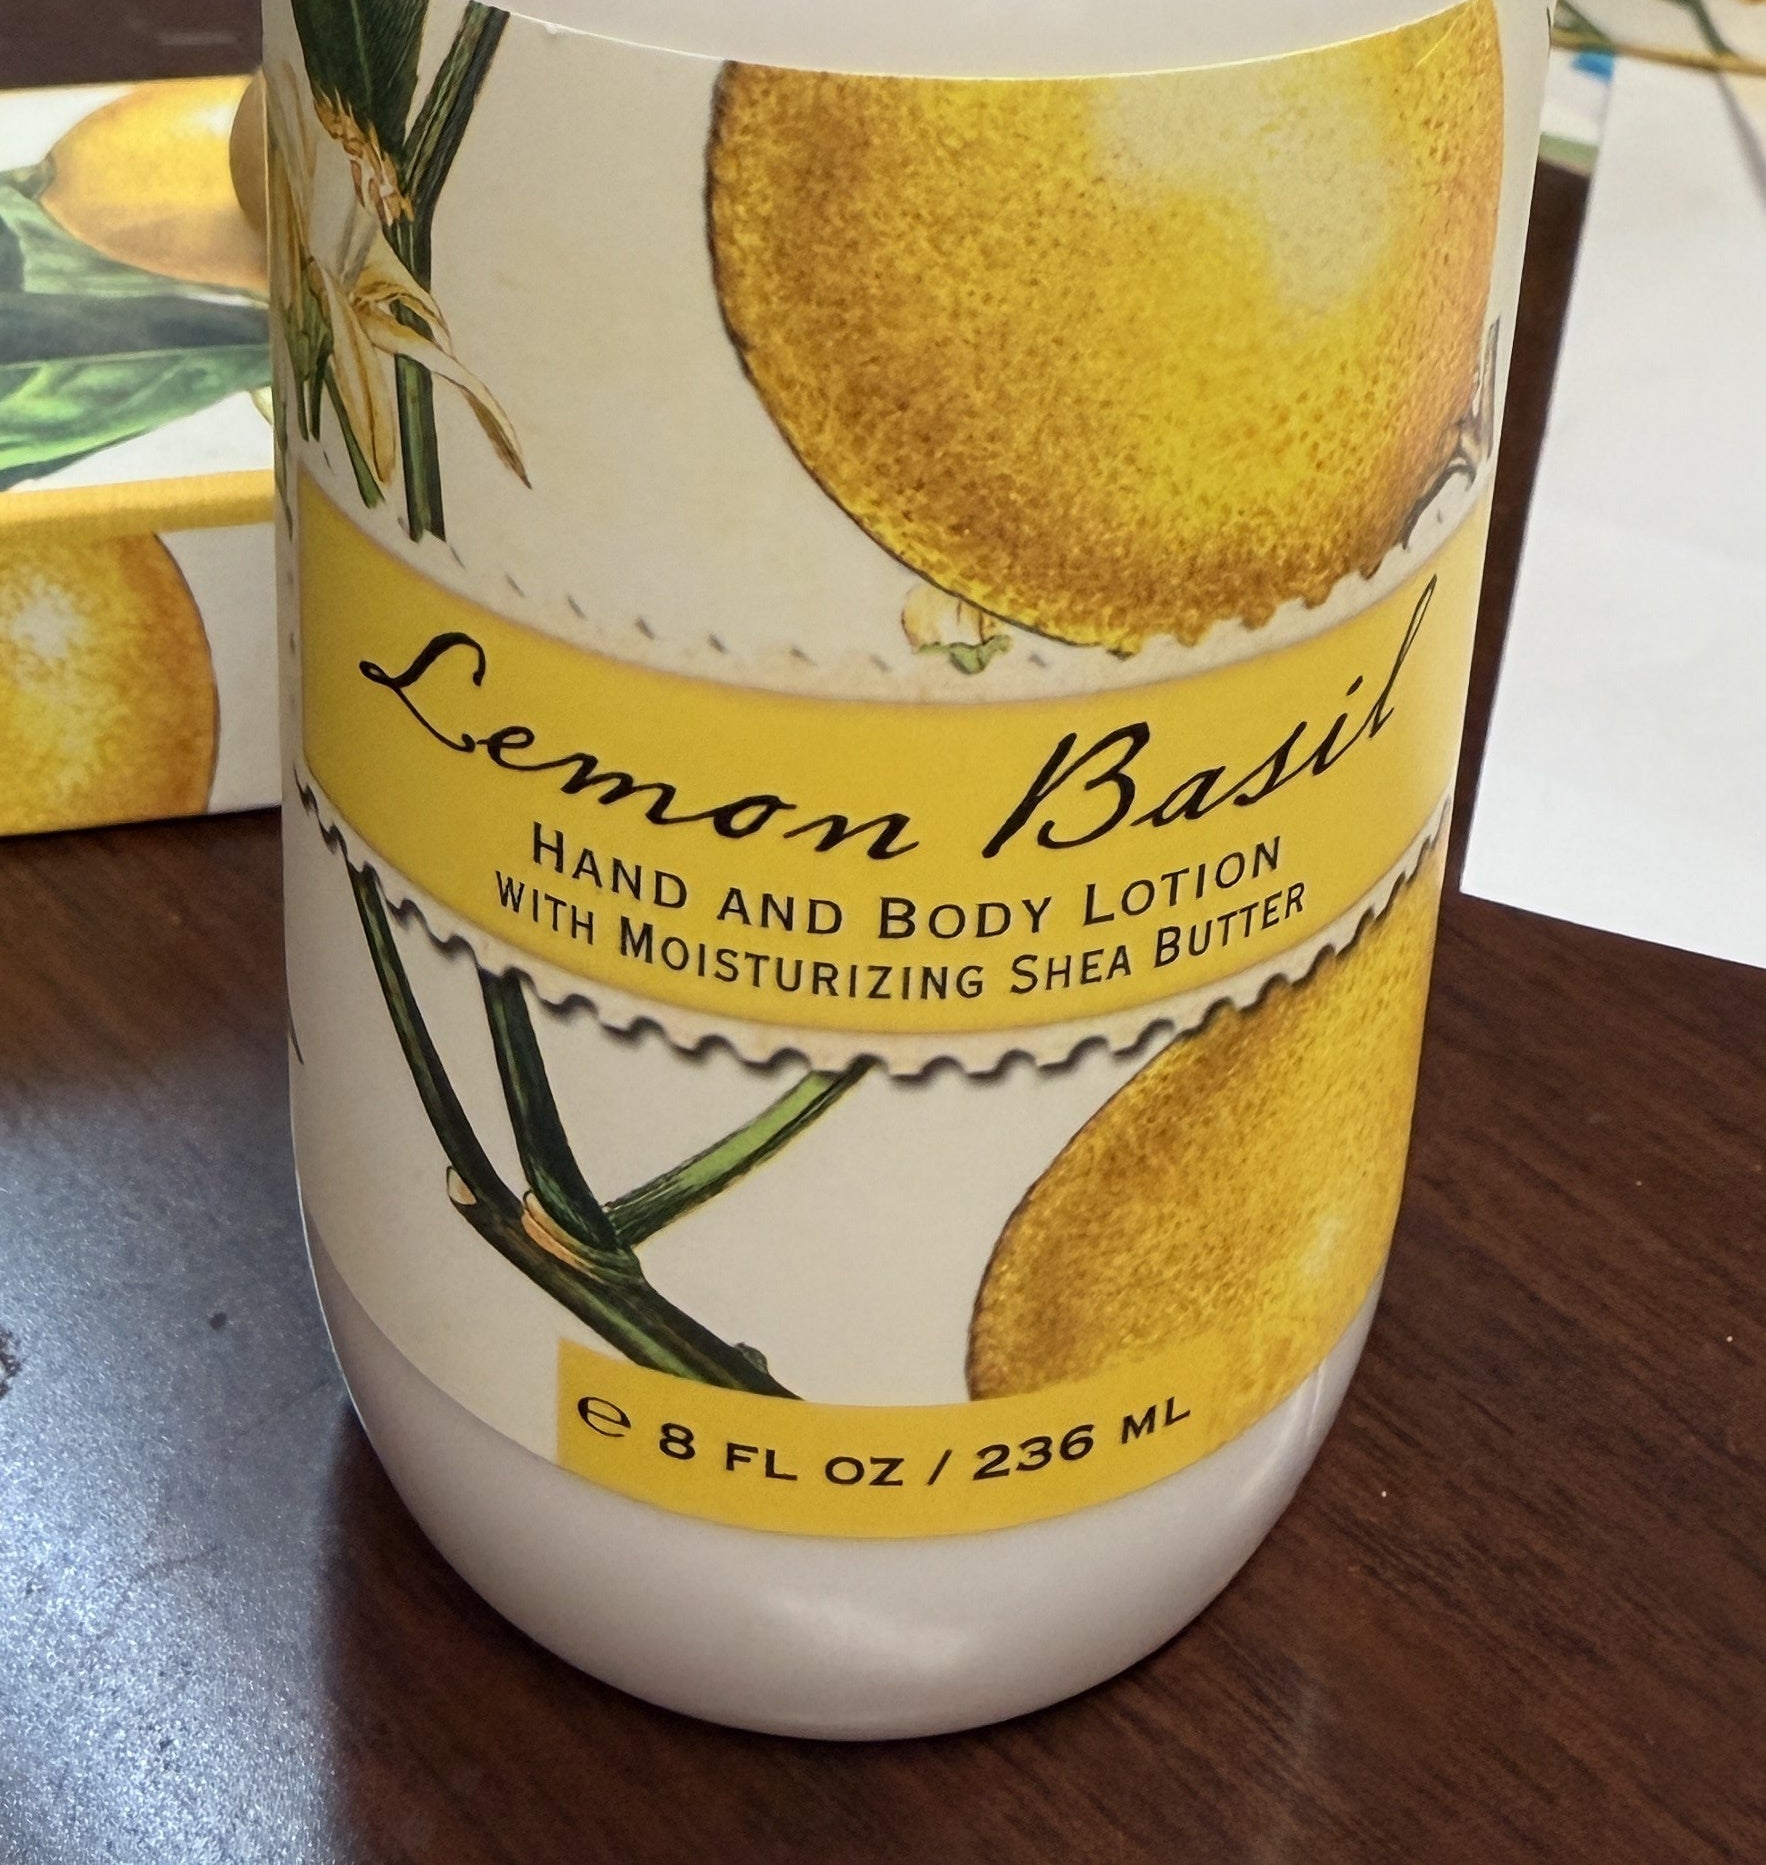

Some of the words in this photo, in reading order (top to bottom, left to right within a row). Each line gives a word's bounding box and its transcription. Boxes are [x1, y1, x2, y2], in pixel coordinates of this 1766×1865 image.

[360, 632, 919, 860] Lemon
[981, 574, 1438, 859] Basil
[494, 871, 594, 945] WITH
[619, 916, 985, 1000] MOISTURIZING
[1010, 946, 1133, 995] SHEA
[1154, 882, 1305, 969] BUTTER
[532, 820, 688, 912] HAND
[716, 888, 843, 936] AND
[879, 895, 1053, 940] BODY
[1082, 836, 1281, 928] LOTION
[659, 1423, 696, 1462] 8
[724, 1443, 798, 1482] FL
[825, 1455, 905, 1487] OZ
[928, 1448, 952, 1486] /
[972, 1423, 1096, 1482] 236
[1120, 1396, 1192, 1445] ML
